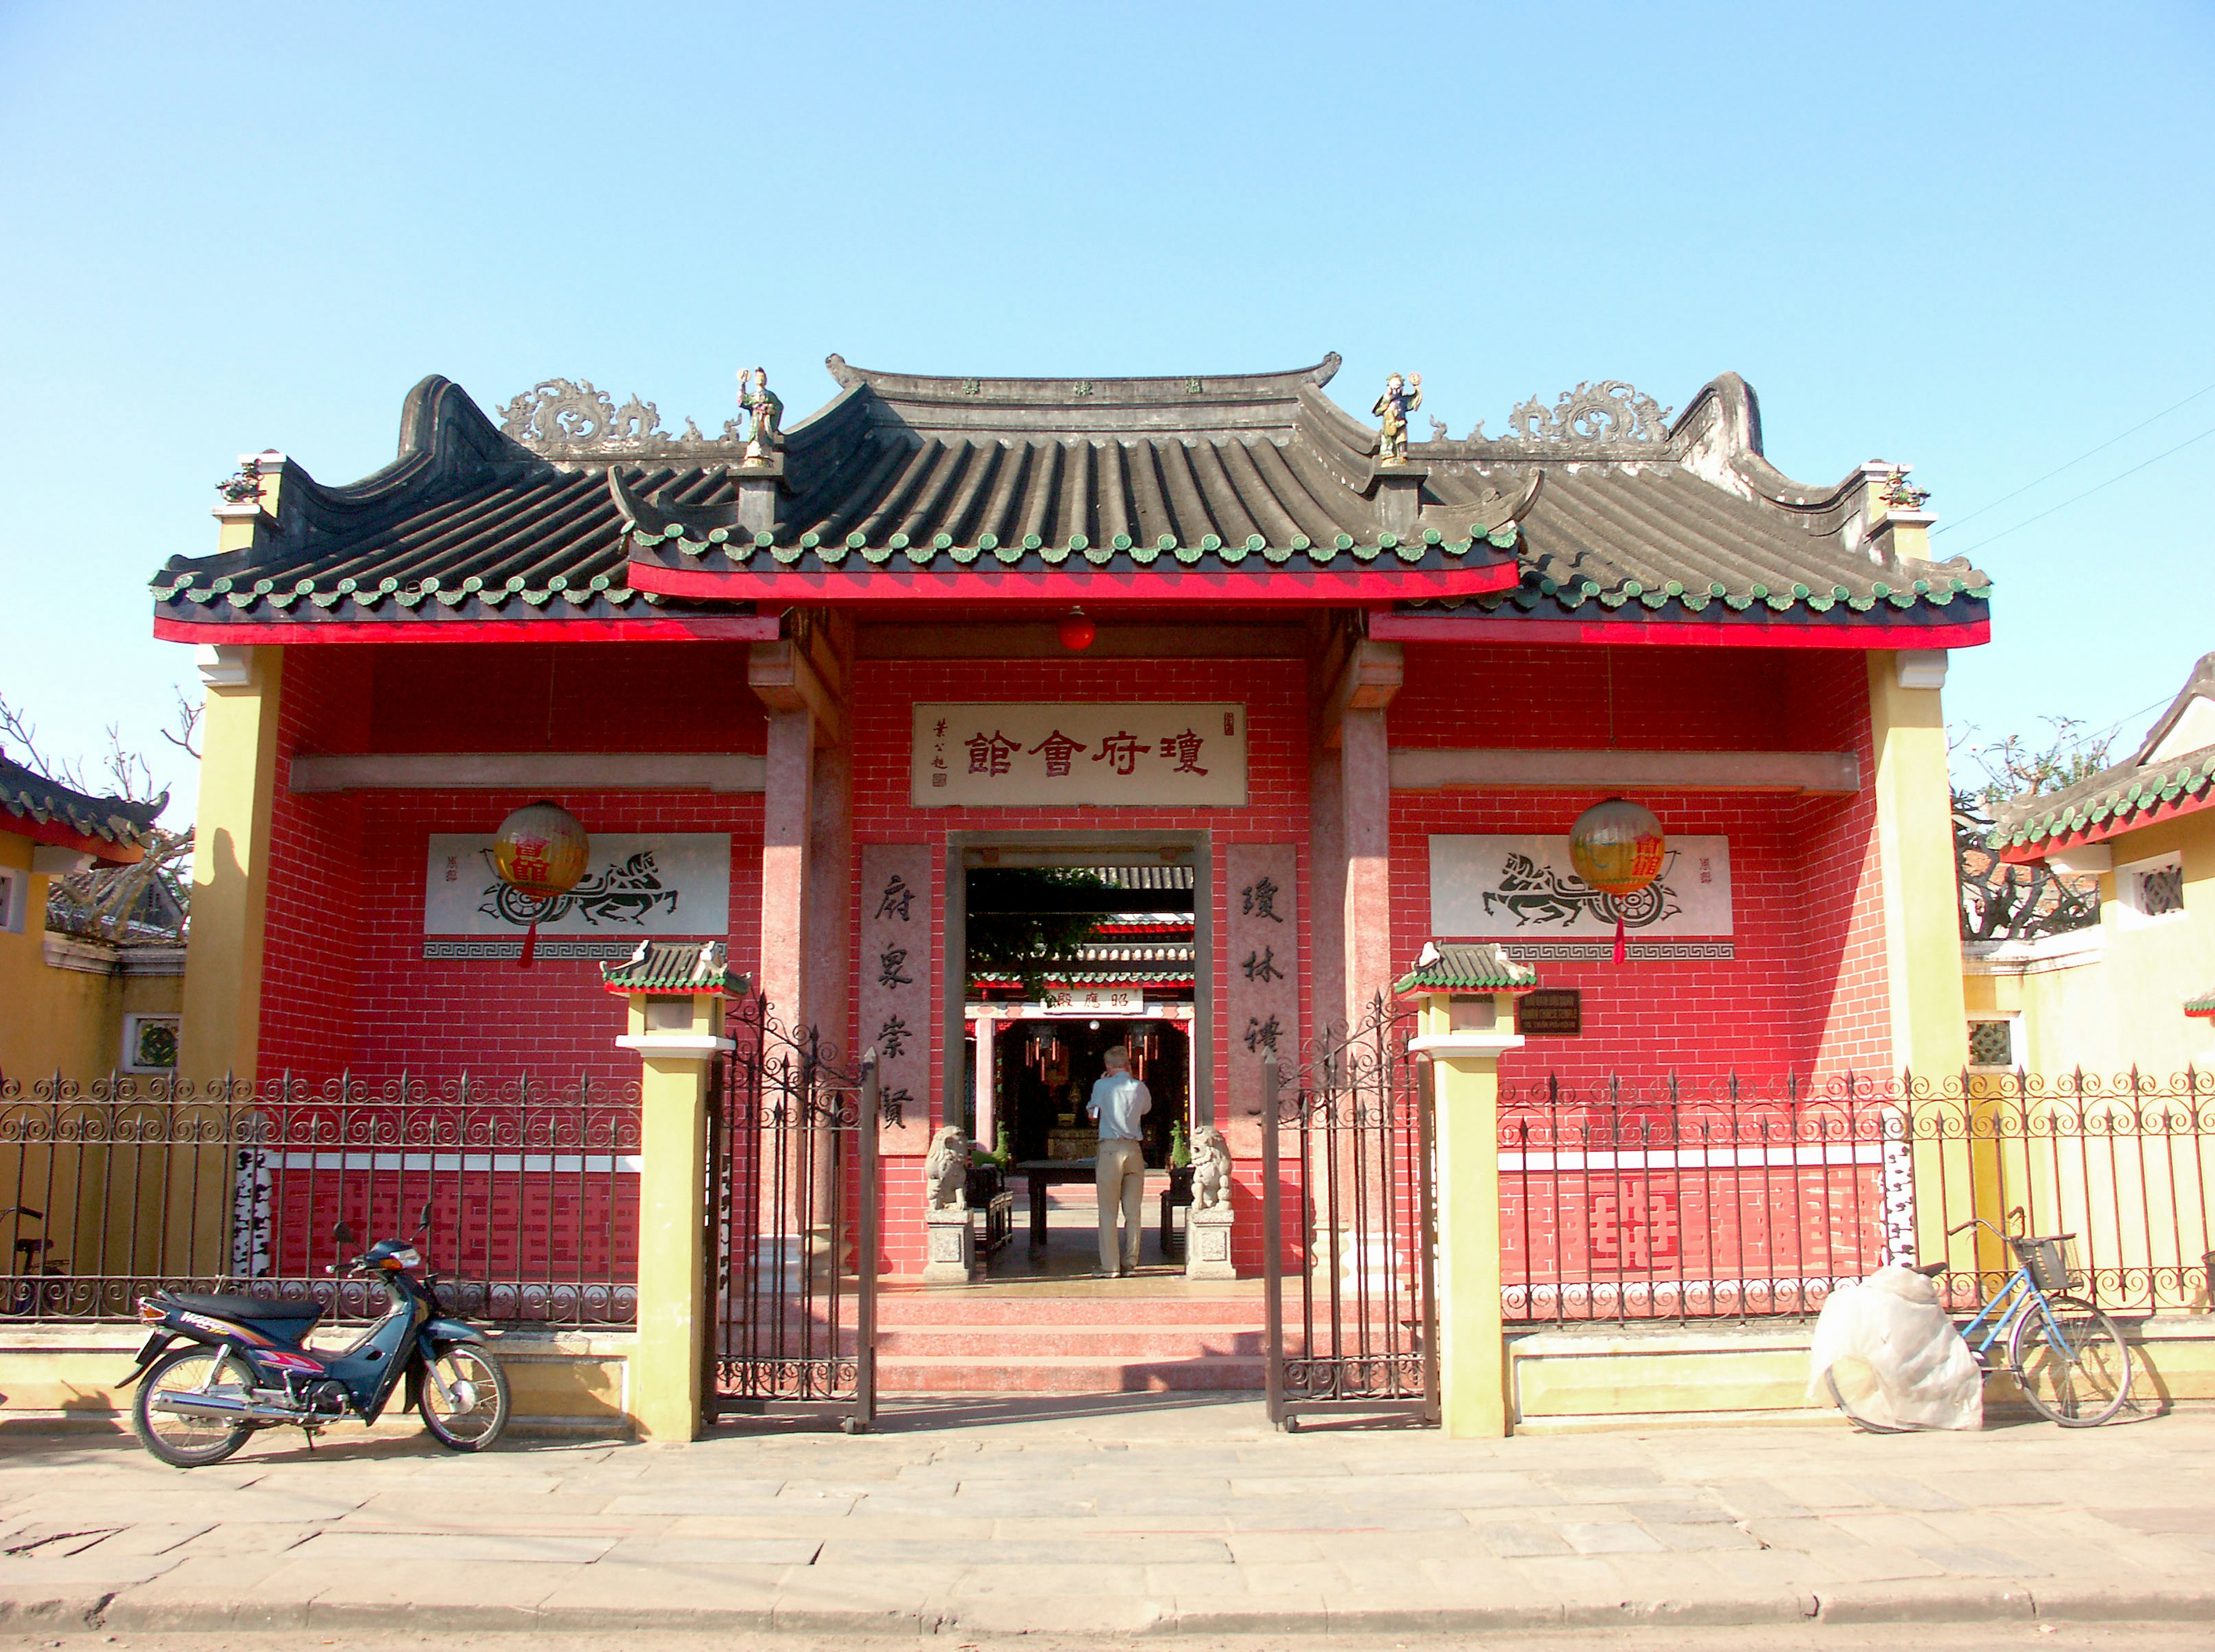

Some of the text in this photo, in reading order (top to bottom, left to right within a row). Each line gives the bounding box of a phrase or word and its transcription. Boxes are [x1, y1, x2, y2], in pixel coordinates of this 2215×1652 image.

[964, 727, 1209, 778] 瓊府會館
[1057, 992, 1129, 1008] 昭應殿
[1241, 877, 1284, 1128] 瓊林禮
